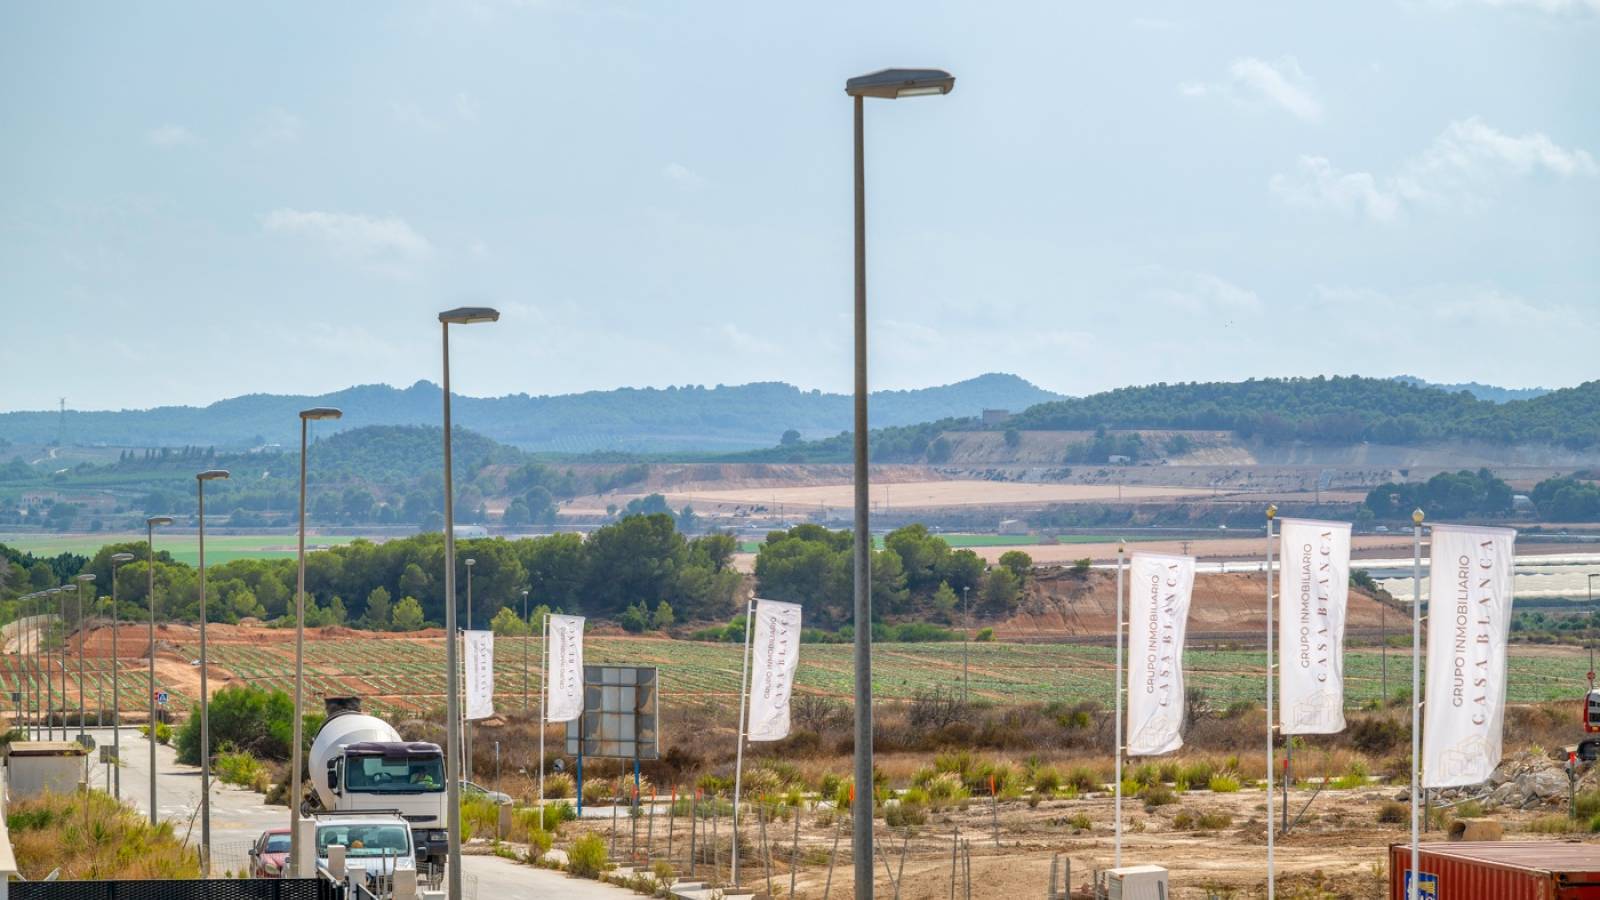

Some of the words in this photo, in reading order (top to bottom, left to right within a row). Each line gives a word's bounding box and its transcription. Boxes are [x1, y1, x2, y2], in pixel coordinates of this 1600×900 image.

[1163, 564, 1177, 643] BLANCA
[1301, 544, 1312, 623] INMOBILIARIO
[1318, 531, 1331, 616] BLANCA
[1456, 555, 1470, 653] INMOBILIARIO
[1477, 540, 1493, 644] BLANCA
[1148, 575, 1159, 651] INMOBILIARIO
[1146, 655, 1156, 694] GRUPO
[1300, 628, 1310, 668] GRUPO
[1316, 628, 1327, 682] CASA
[764, 672, 772, 699] GRUPO
[1159, 656, 1170, 707] CASA
[1453, 657, 1464, 707] GRUPO
[1472, 660, 1488, 725] CASA
